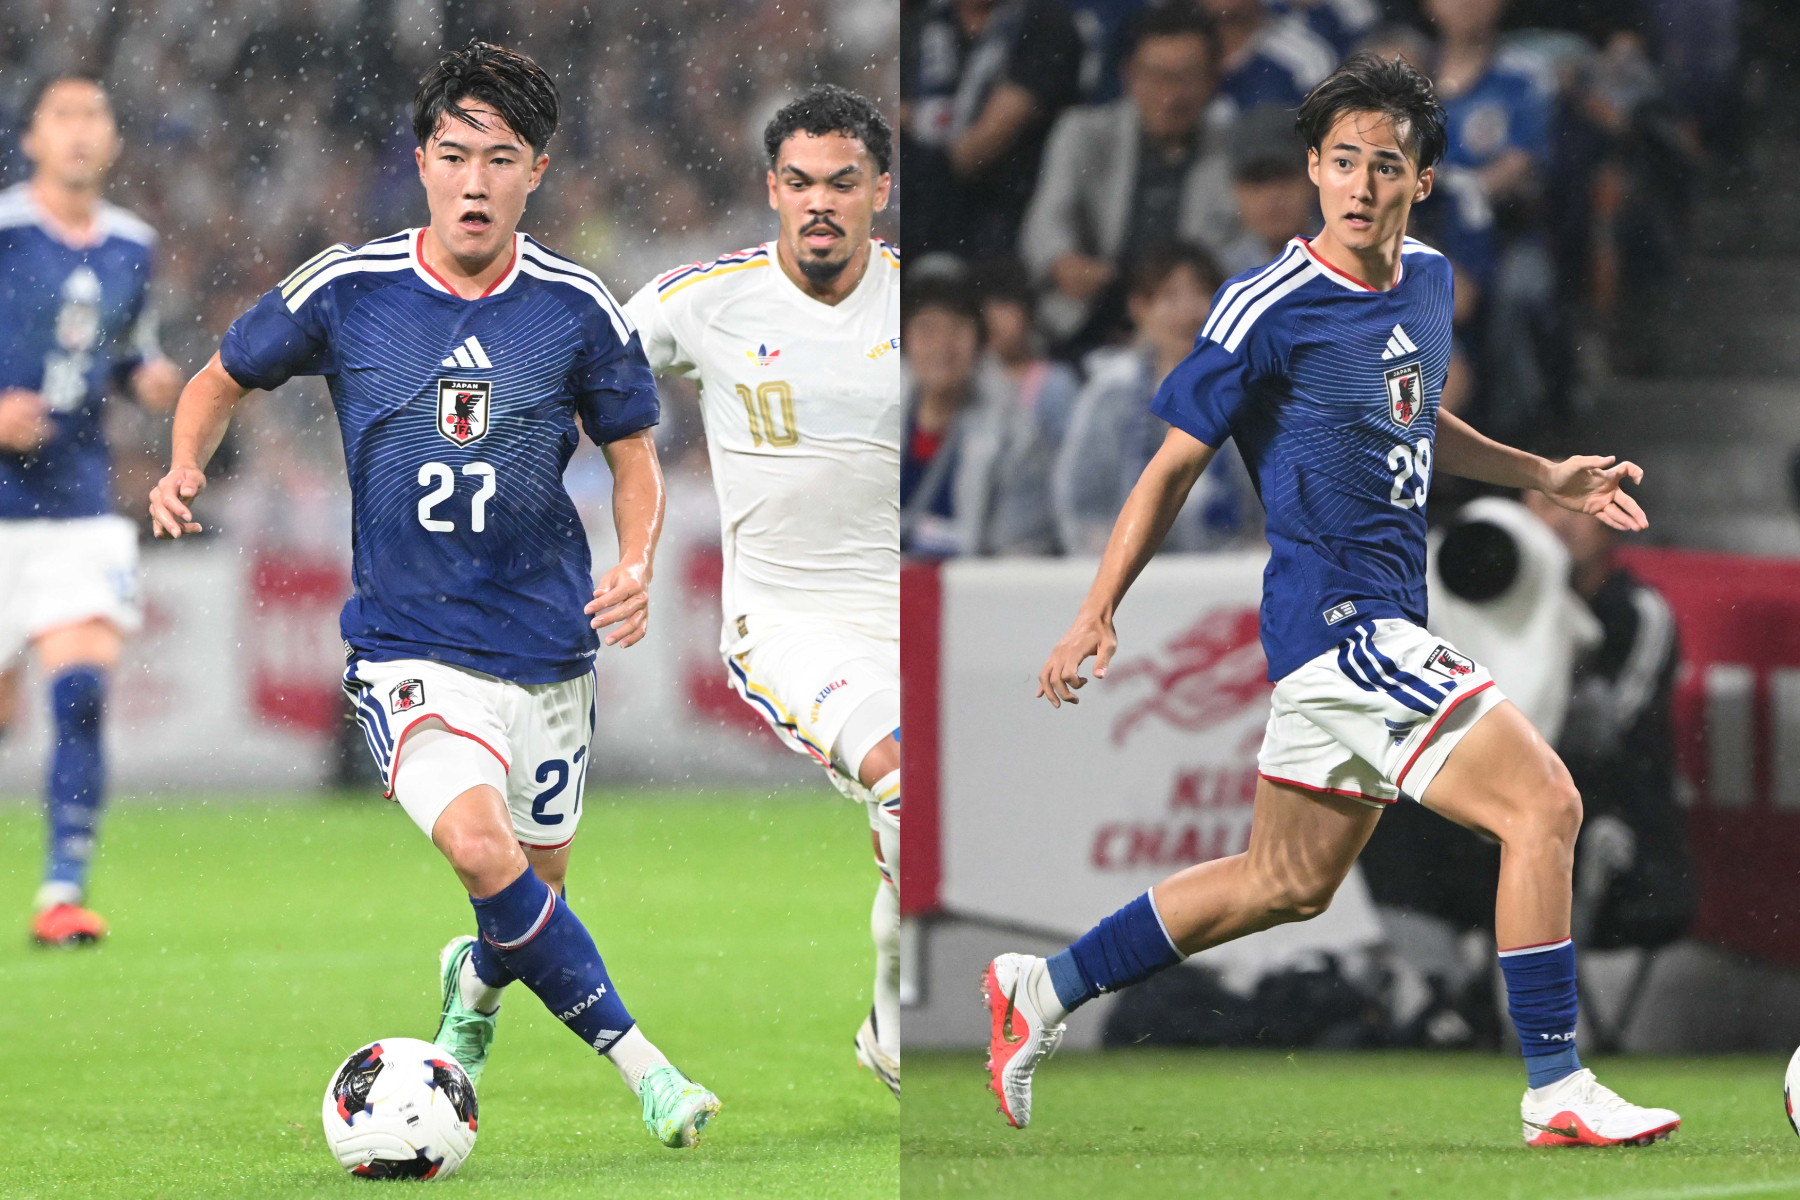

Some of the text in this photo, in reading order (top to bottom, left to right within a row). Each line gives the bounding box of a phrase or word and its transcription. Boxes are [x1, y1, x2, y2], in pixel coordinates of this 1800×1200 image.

[1393, 367, 1412, 376] JAPAN
[450, 424, 474, 436] JFA
[735, 380, 798, 448] 10
[418, 462, 496, 532] 27
[1388, 437, 1431, 509] 29
[810, 679, 848, 724] VENEZUELA
[531, 744, 586, 825] 27
